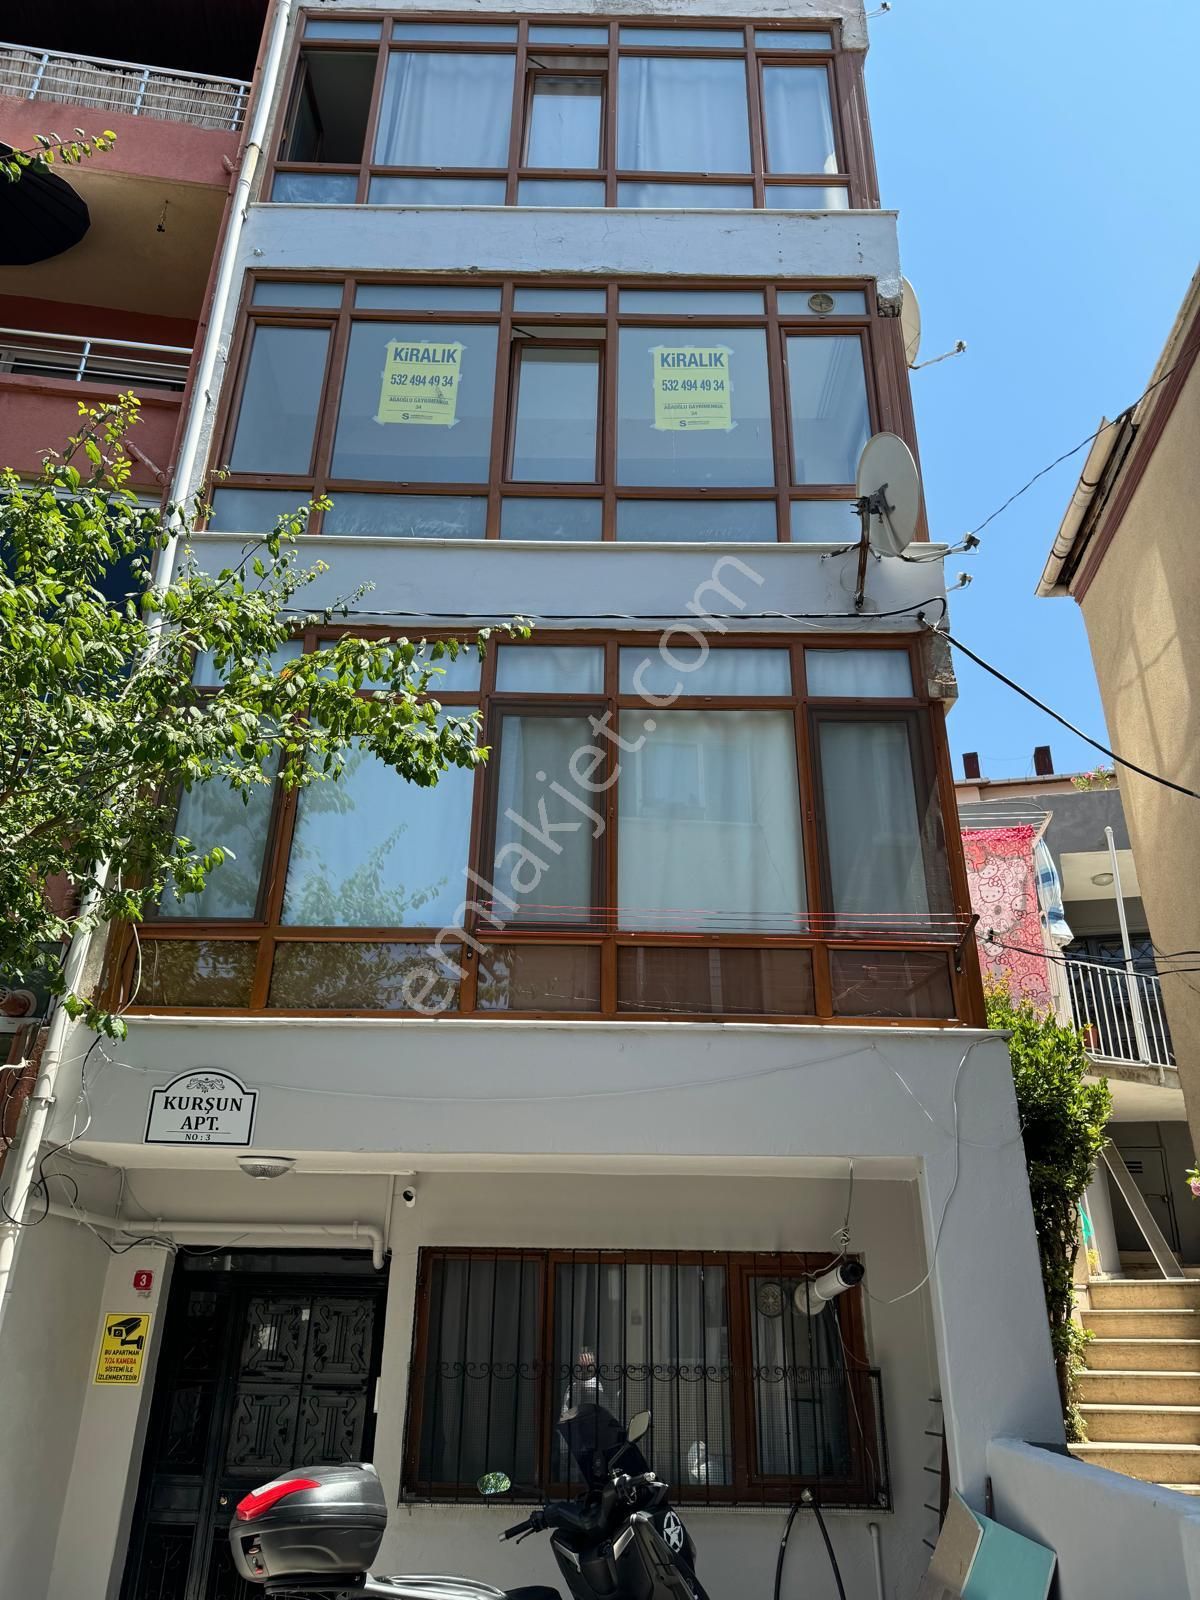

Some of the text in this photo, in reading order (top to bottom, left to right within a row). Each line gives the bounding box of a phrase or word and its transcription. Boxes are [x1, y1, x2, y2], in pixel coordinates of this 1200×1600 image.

[390, 373, 454, 388] 532 494 49 34
[661, 379, 725, 392] 532 494 49 34
[162, 1095, 243, 1115] KURŞUN
[179, 1115, 219, 1131] APT.
[139, 1274, 148, 1287] 3
[104, 1357, 137, 1365] 7/24 KAMERA
